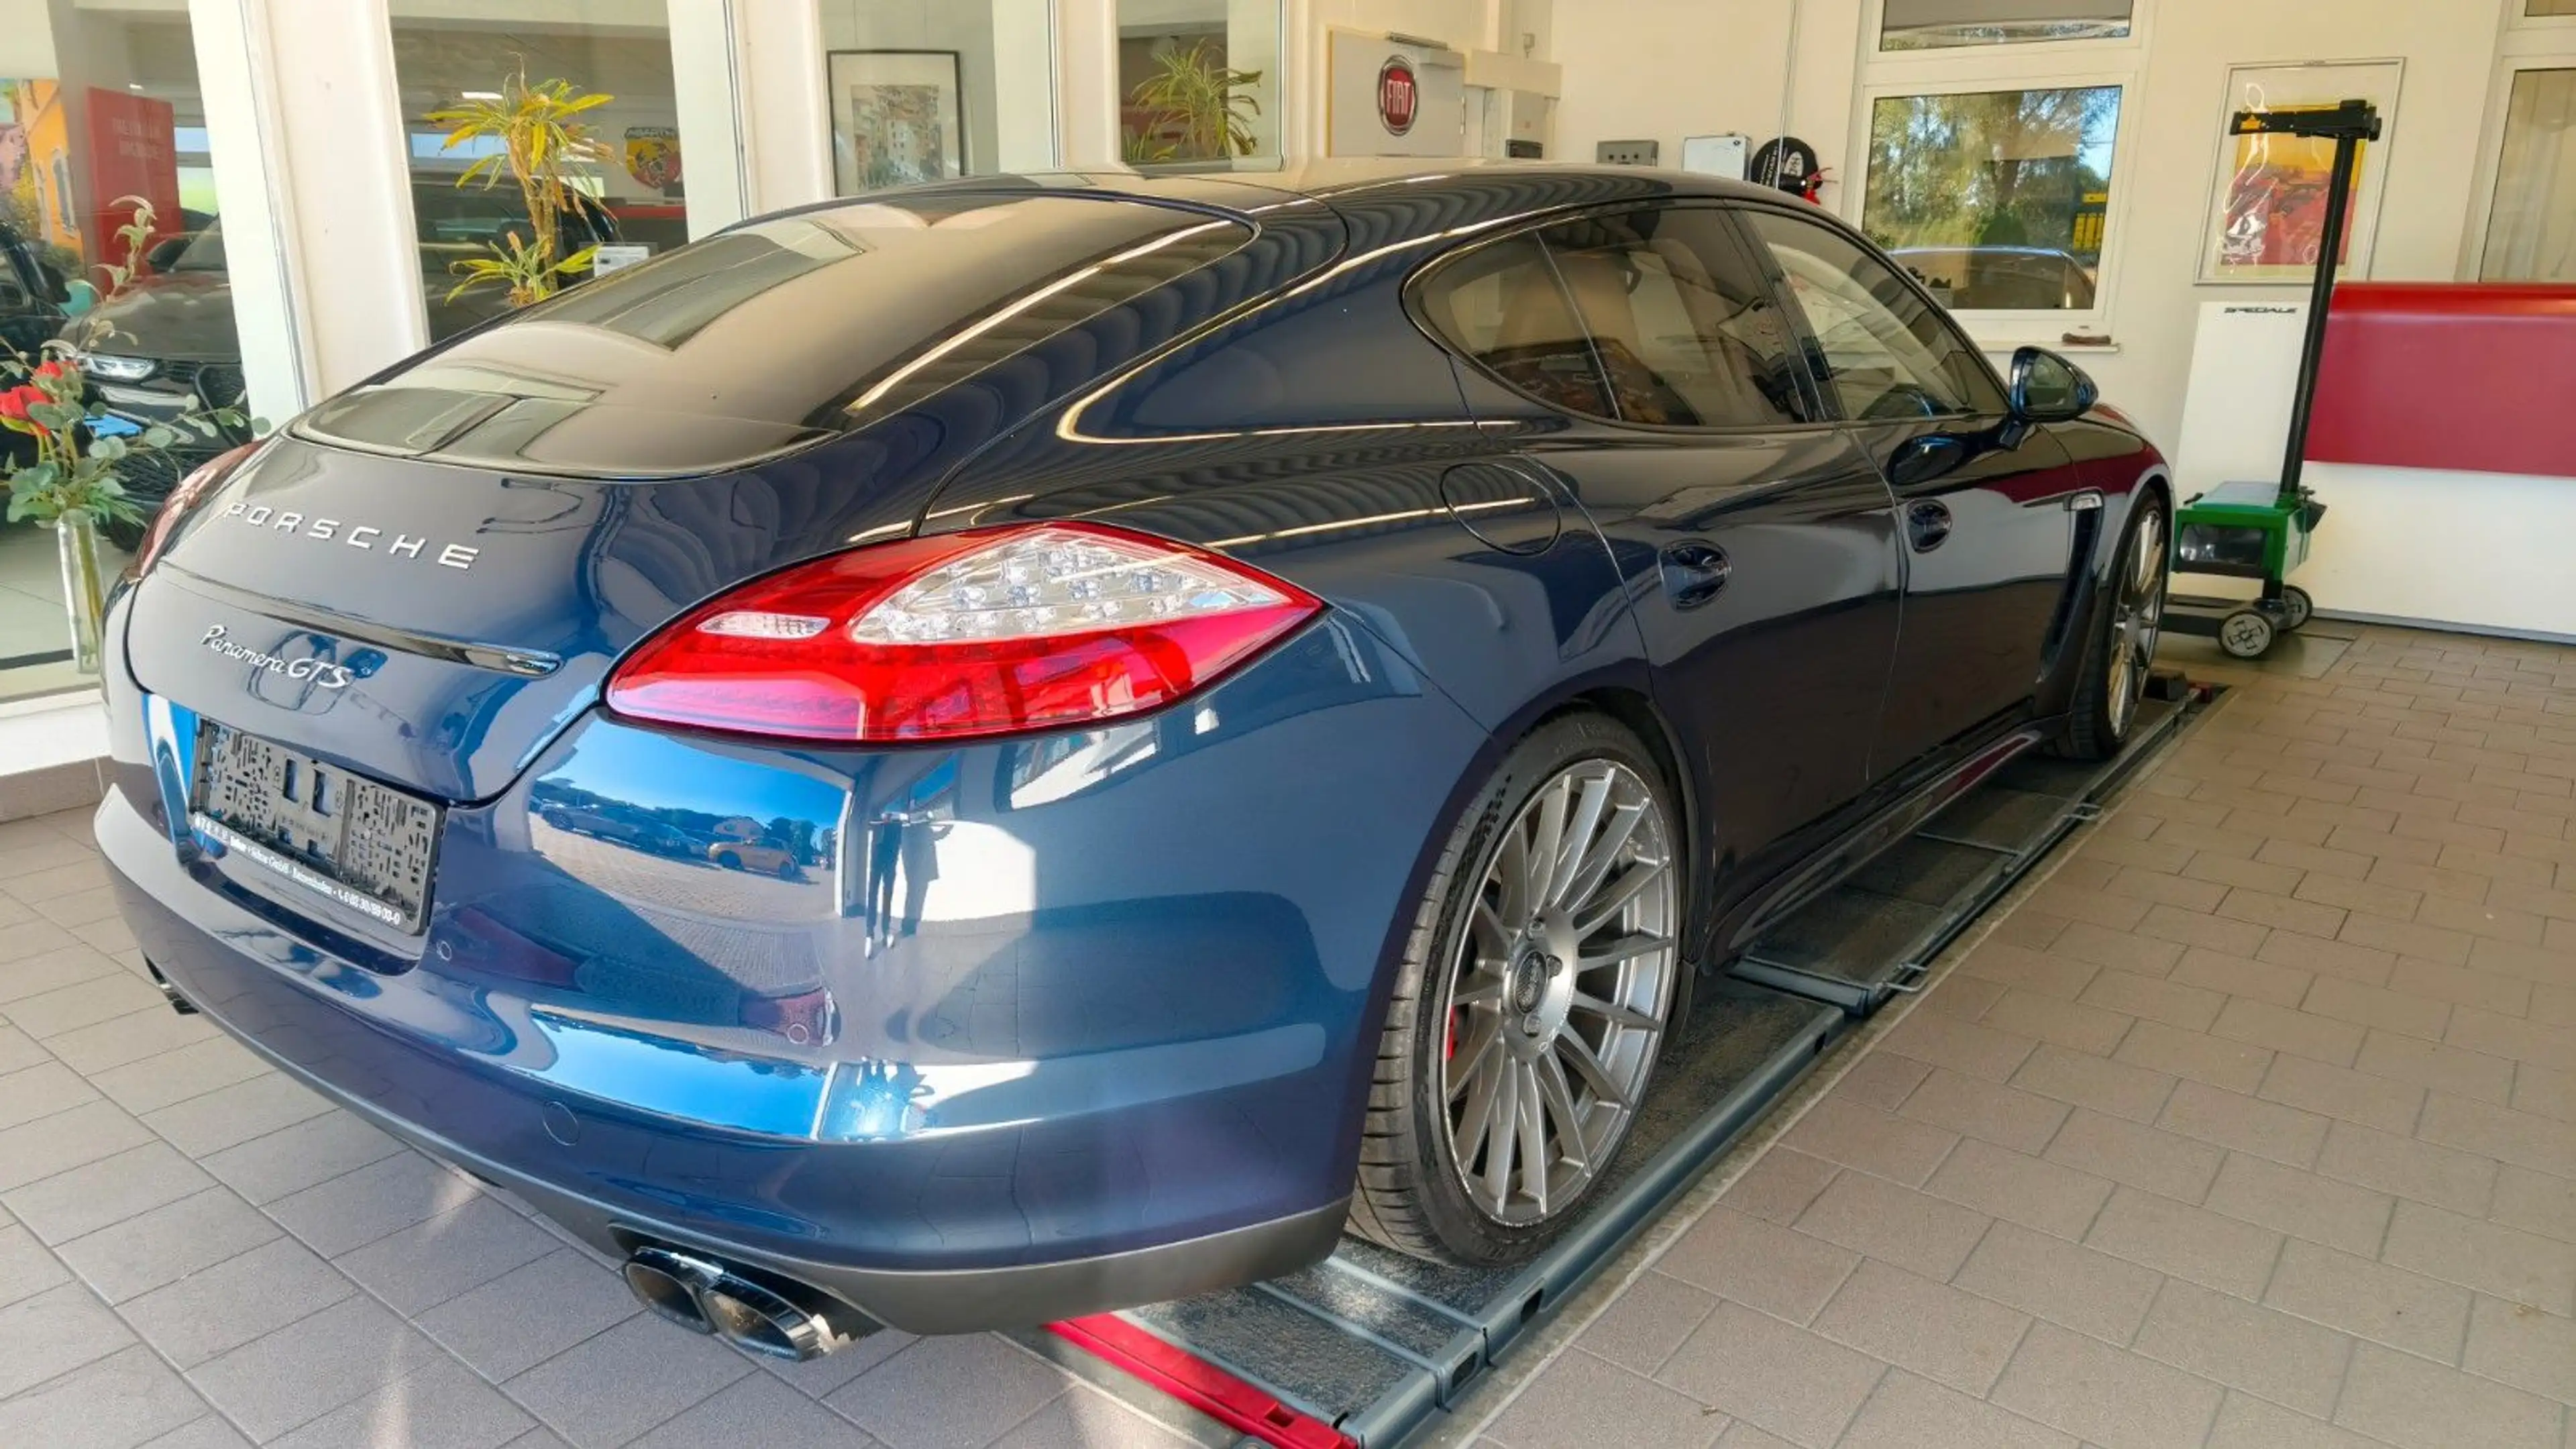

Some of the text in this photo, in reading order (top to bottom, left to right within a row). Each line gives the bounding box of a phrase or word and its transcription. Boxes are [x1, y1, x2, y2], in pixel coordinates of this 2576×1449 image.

[1386, 78, 1410, 115] FIAT
[227, 502, 479, 570] PORSCHE
[201, 624, 352, 688] Panamera GTS
